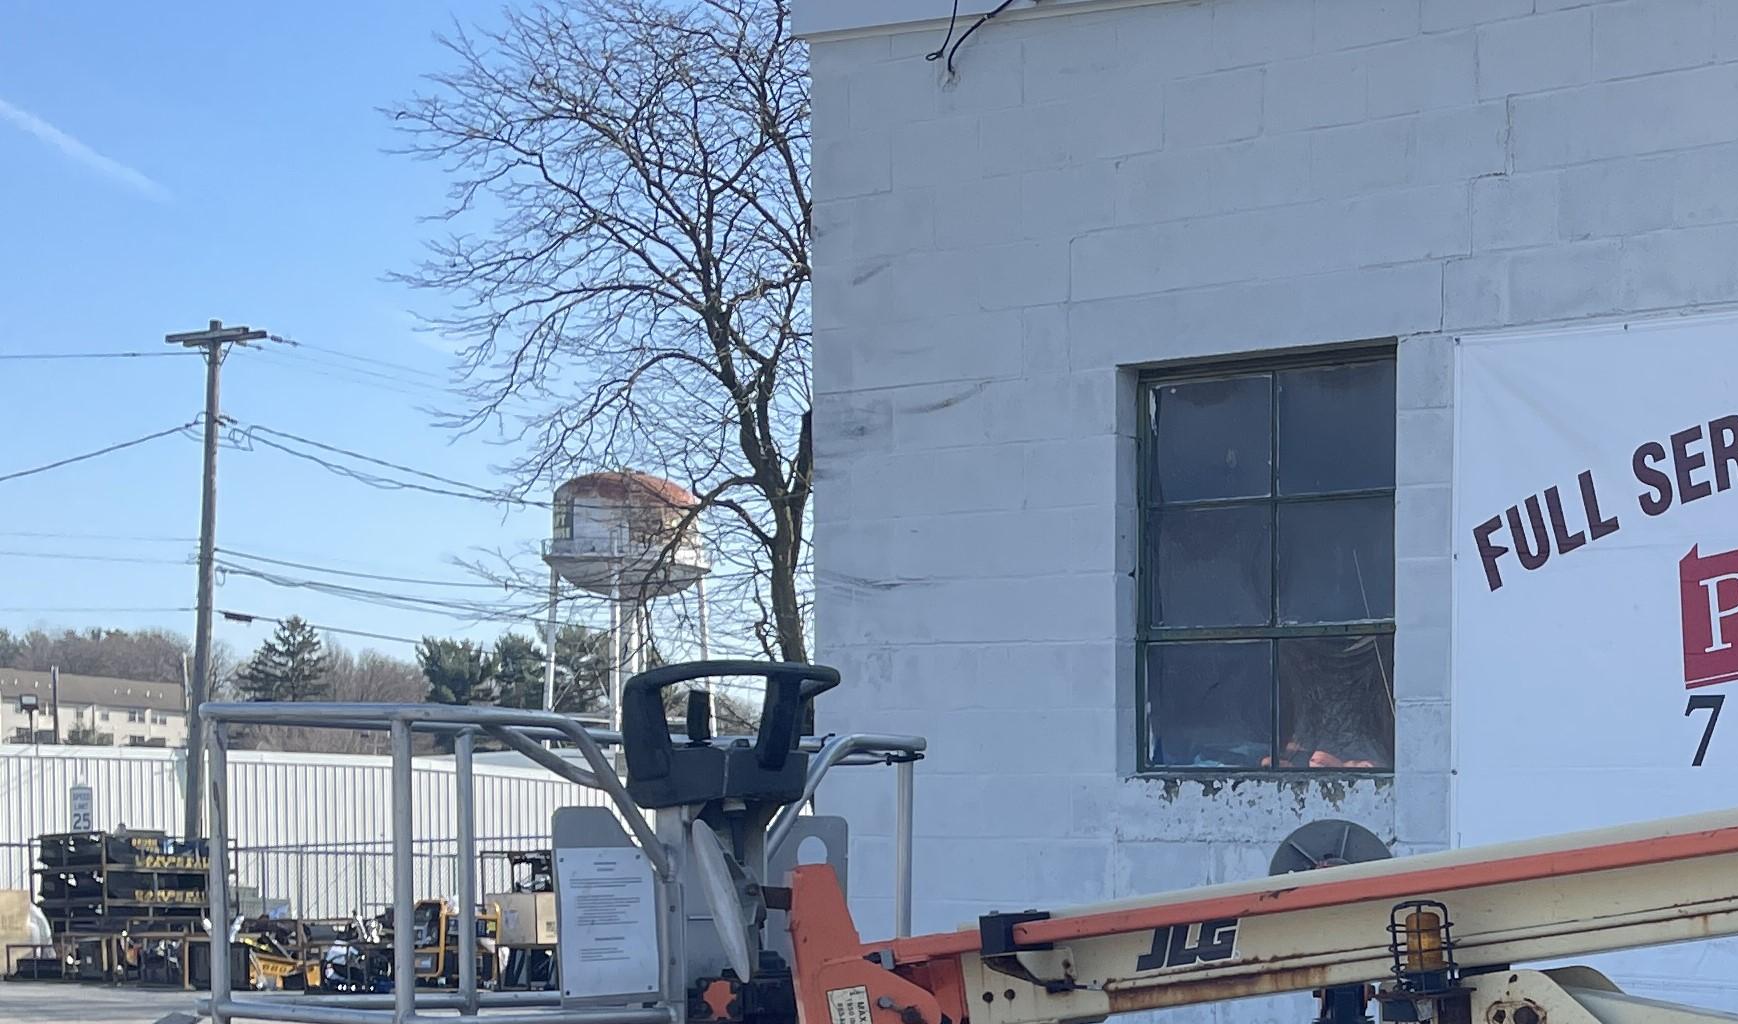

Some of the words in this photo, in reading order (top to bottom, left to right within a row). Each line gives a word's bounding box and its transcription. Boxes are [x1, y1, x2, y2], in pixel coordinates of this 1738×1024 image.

[1473, 469, 1620, 592] FULL
[73, 813, 91, 830] 25
[1136, 918, 1239, 972] JLG
